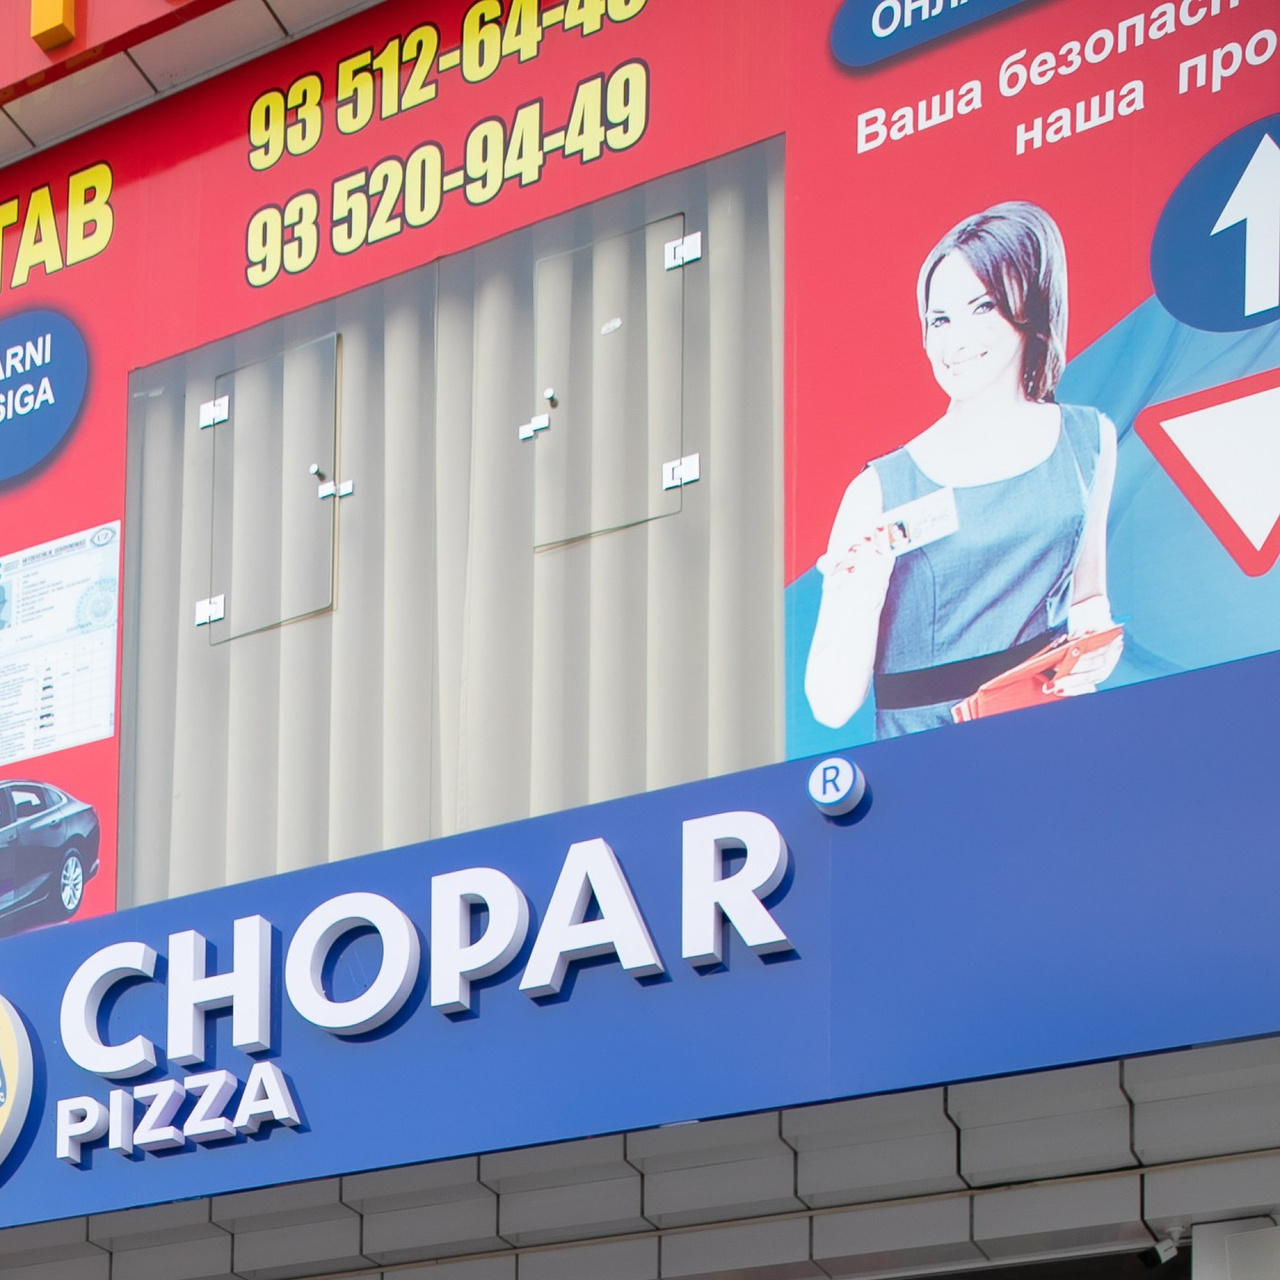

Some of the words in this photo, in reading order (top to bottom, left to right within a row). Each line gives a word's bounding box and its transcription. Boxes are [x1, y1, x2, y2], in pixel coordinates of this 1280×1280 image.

[247, 73, 324, 172] 93
[856, 79, 983, 154] Ваша
[1016, 79, 1145, 155] наша
[245, 190, 320, 287] 93
[330, 58, 649, 257] 520-94-49
[60, 811, 800, 1080] CHOPAR
[56, 1063, 307, 1166] PIZZA
